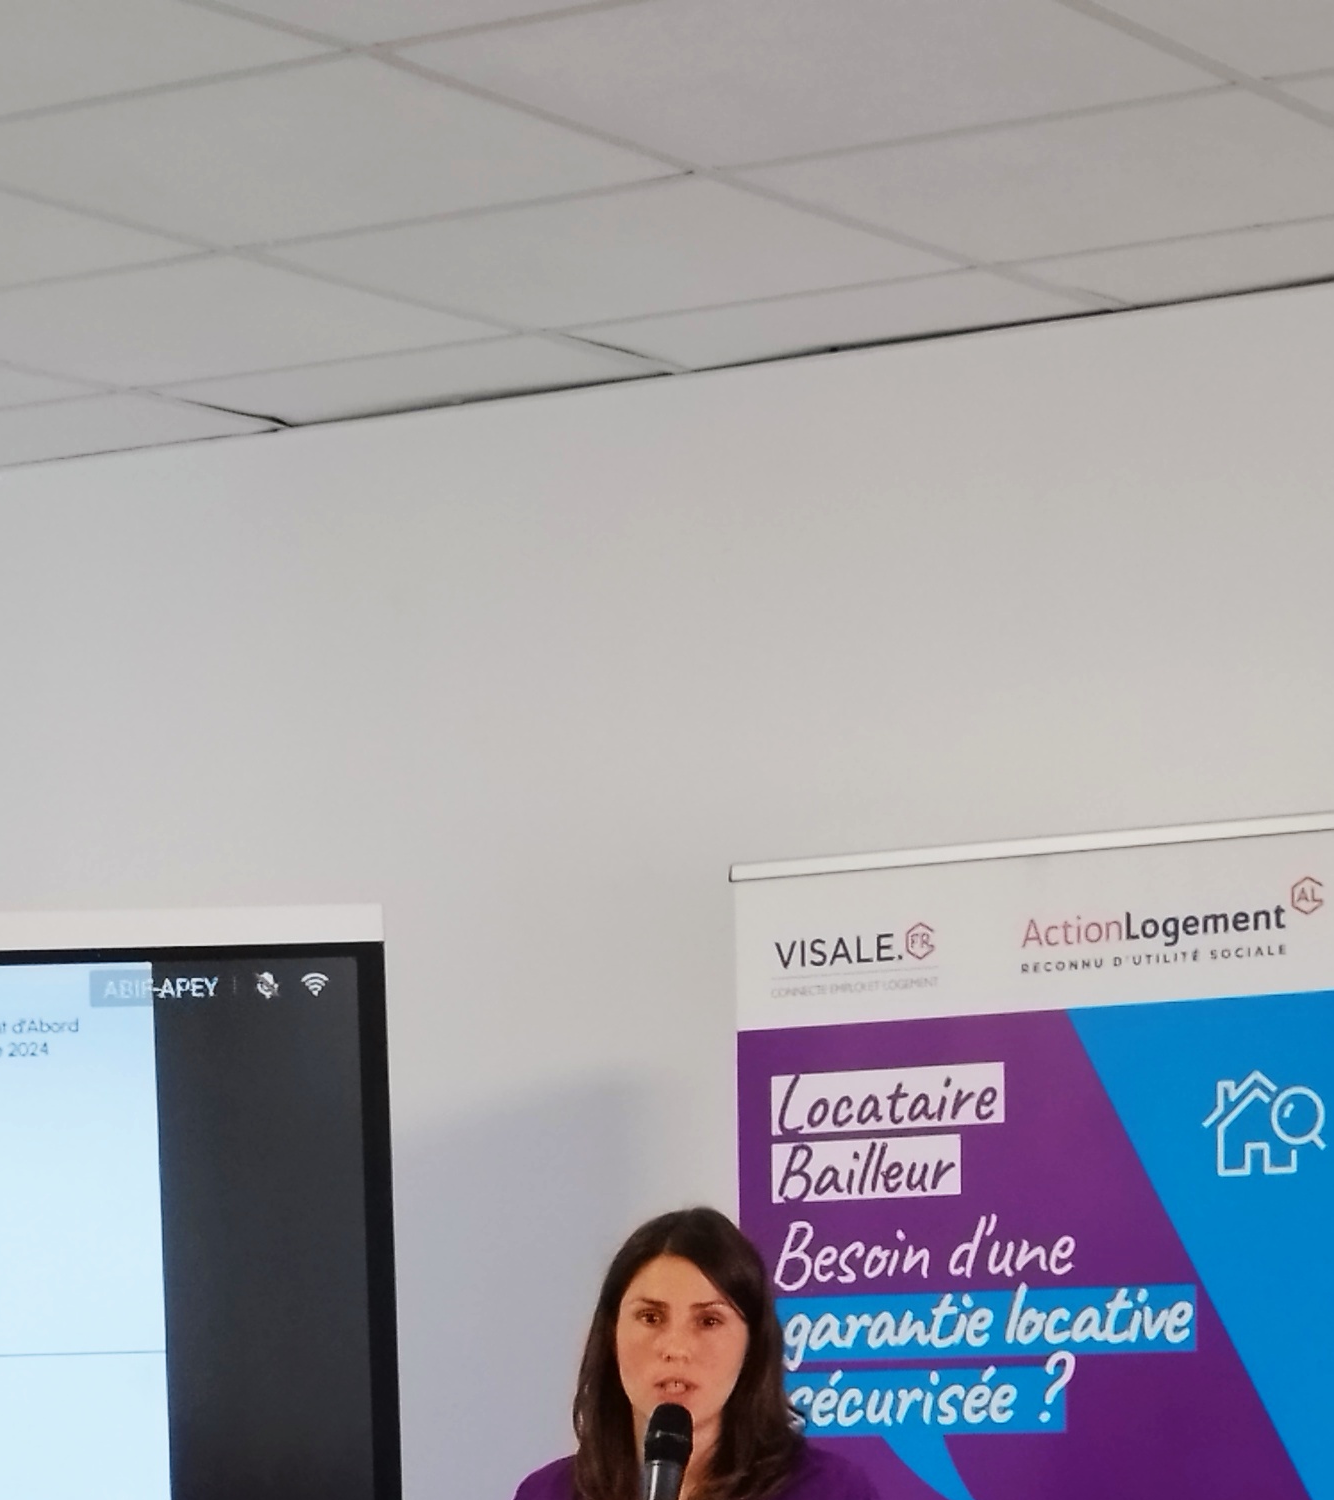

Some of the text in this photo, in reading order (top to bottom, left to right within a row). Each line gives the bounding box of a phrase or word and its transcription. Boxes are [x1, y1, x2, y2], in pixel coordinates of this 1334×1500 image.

[1020, 944, 1286, 974] RECONNU D'UTILITÉ SOCIALE
[8, 1042, 49, 1058] 2024
[12, 1018, 80, 1034] d'Abord
[776, 1074, 998, 1134] Locataire
[777, 1142, 957, 1202] Bailleur
[773, 1213, 1076, 1291] Besoin d'une
[783, 1282, 1194, 1373] garantie locative
[1037, 1350, 1076, 1424] ?
